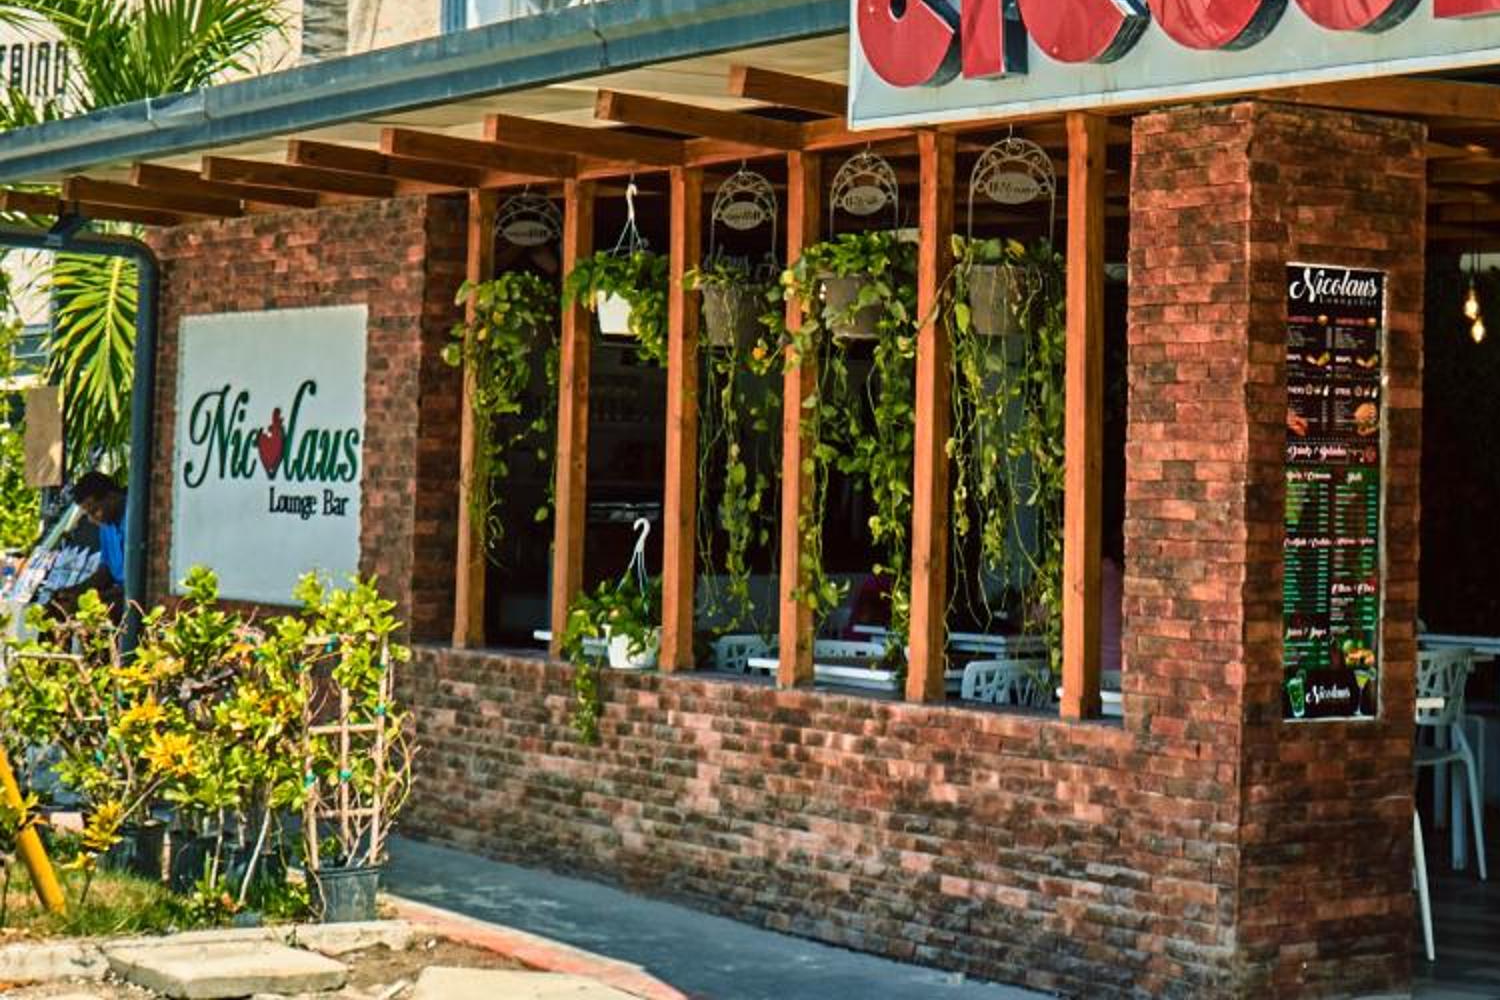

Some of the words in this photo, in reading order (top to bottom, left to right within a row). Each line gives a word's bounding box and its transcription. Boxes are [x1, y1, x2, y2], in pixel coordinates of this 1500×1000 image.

[1289, 268, 1378, 303] Nicolaus
[269, 487, 316, 520] Lounge
[323, 489, 349, 516] Bar
